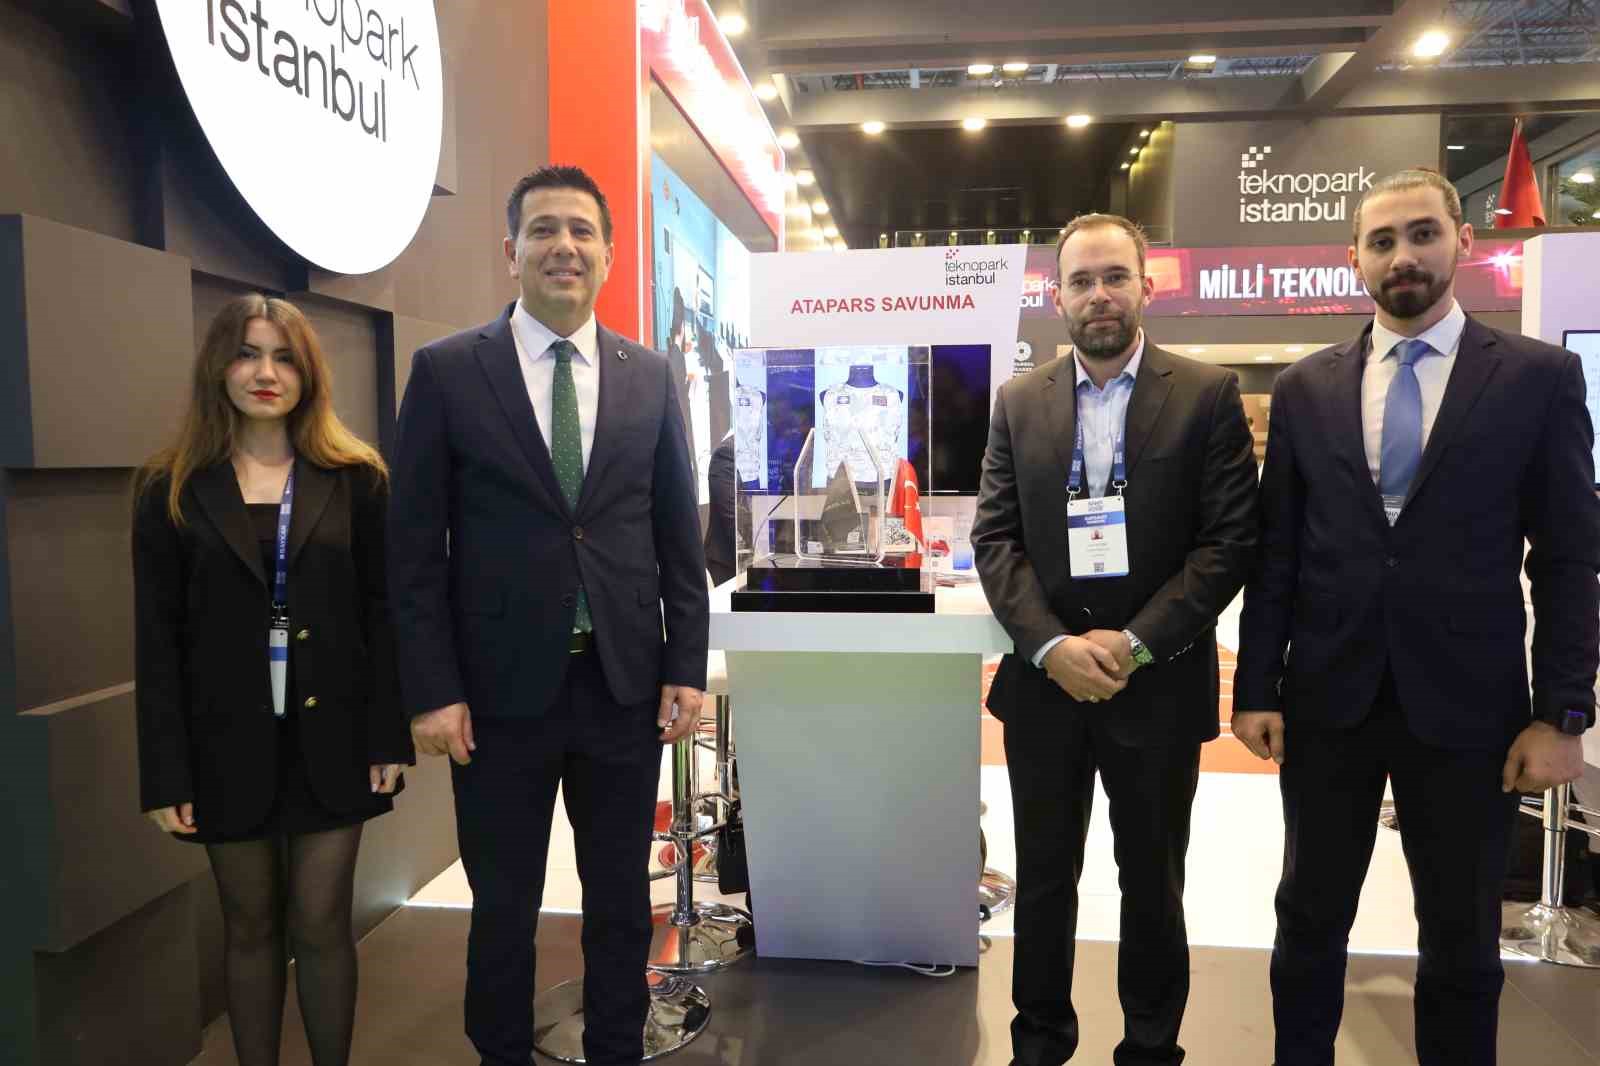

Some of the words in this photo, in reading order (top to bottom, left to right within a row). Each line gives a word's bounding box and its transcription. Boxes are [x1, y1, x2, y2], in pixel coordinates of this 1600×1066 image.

[1238, 166, 1376, 198] teknopark
[1239, 196, 1346, 223] istanbul
[944, 257, 1009, 273] teknopark
[945, 271, 996, 286] istanbul
[1199, 264, 1264, 299] MİLLİ
[1269, 266, 1371, 298] TEKNOL
[791, 297, 876, 315] ATAPARS
[881, 294, 976, 312] SAVUNMA
